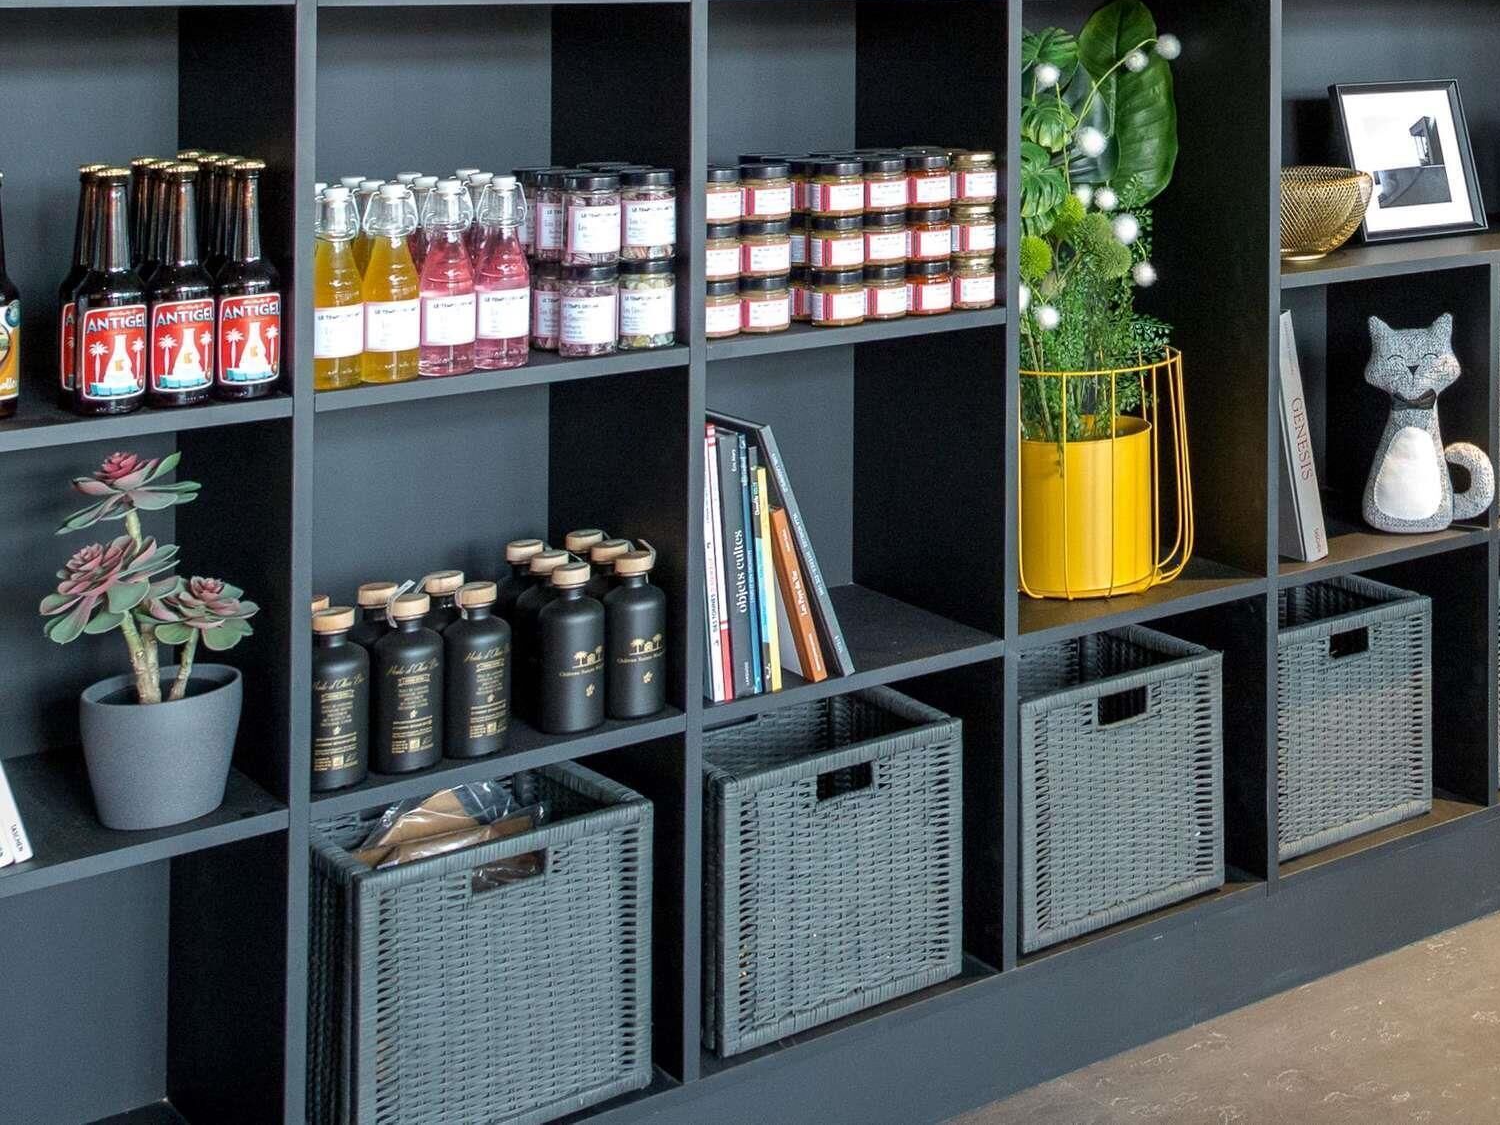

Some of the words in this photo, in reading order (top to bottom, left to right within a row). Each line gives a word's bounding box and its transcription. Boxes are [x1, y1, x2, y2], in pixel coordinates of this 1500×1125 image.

[1290, 396, 1313, 481] GENESIS
[733, 530, 745, 570] cultes
[734, 571, 749, 613] objets
